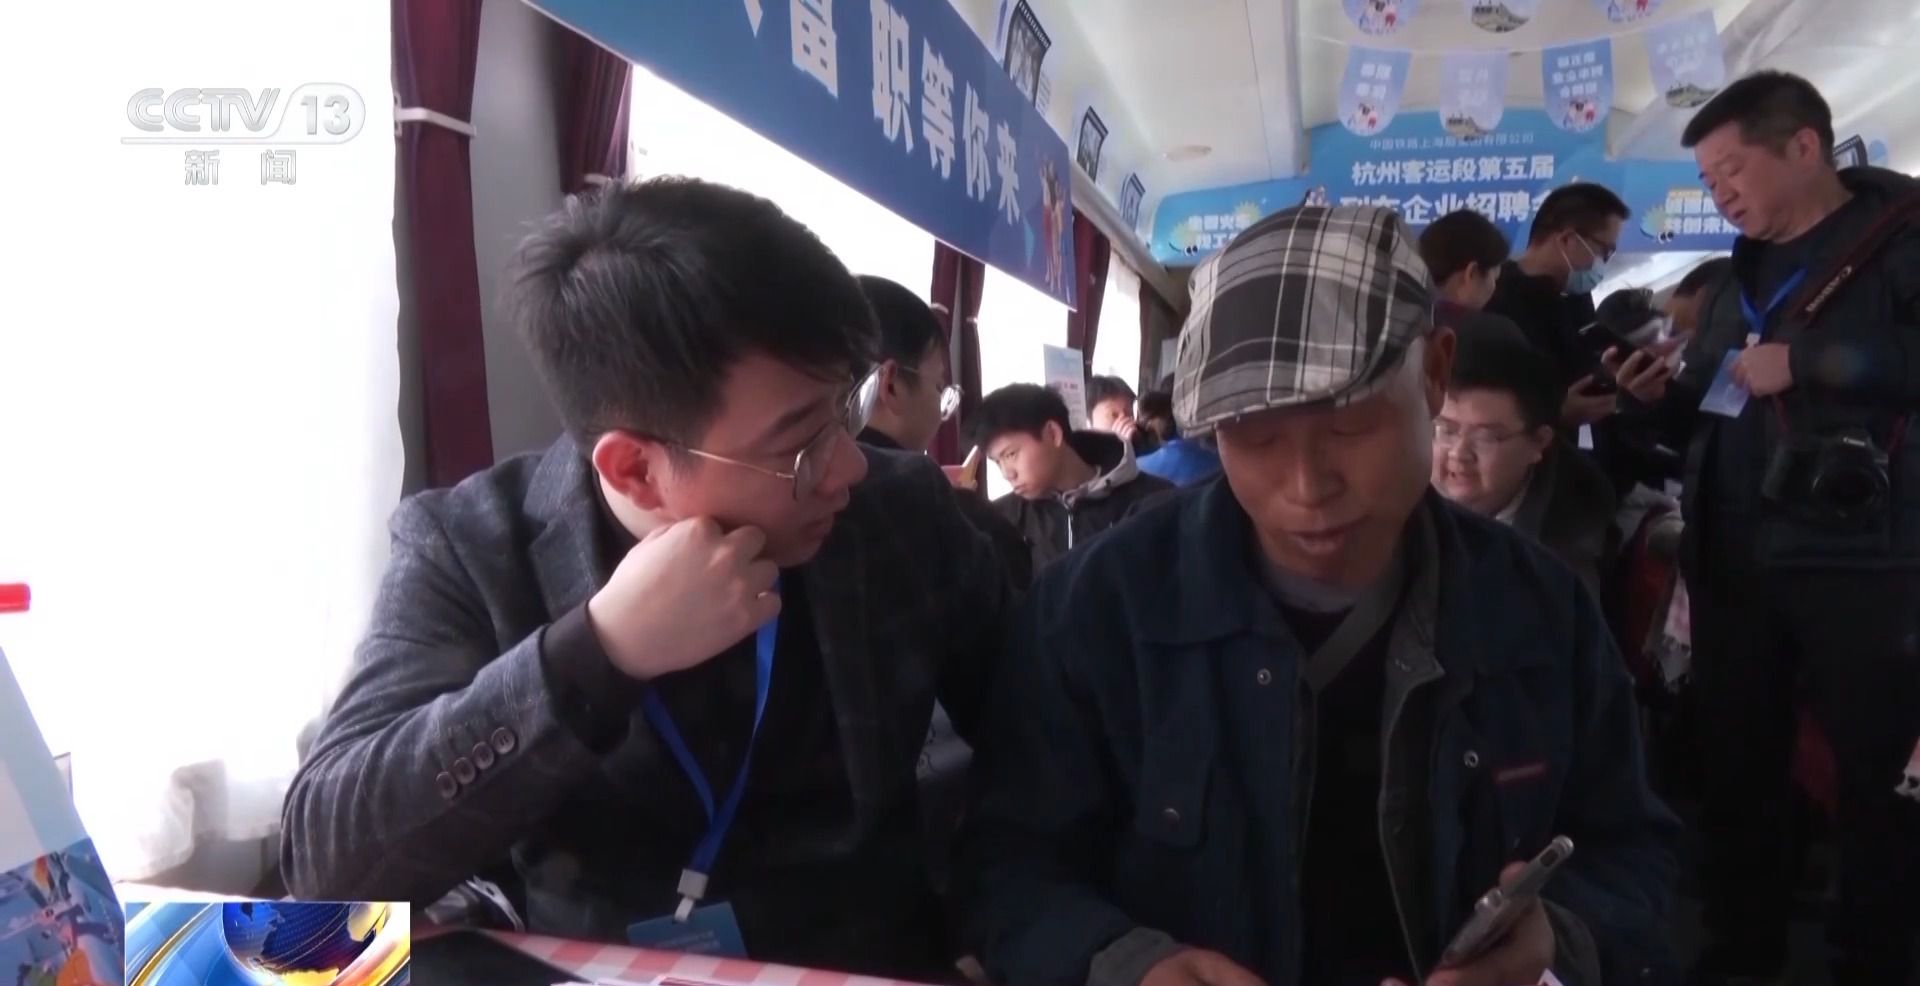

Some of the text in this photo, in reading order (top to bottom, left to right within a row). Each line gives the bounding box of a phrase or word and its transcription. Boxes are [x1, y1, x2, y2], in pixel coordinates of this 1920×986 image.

[1351, 154, 1555, 187] 杭州客运段第五届
